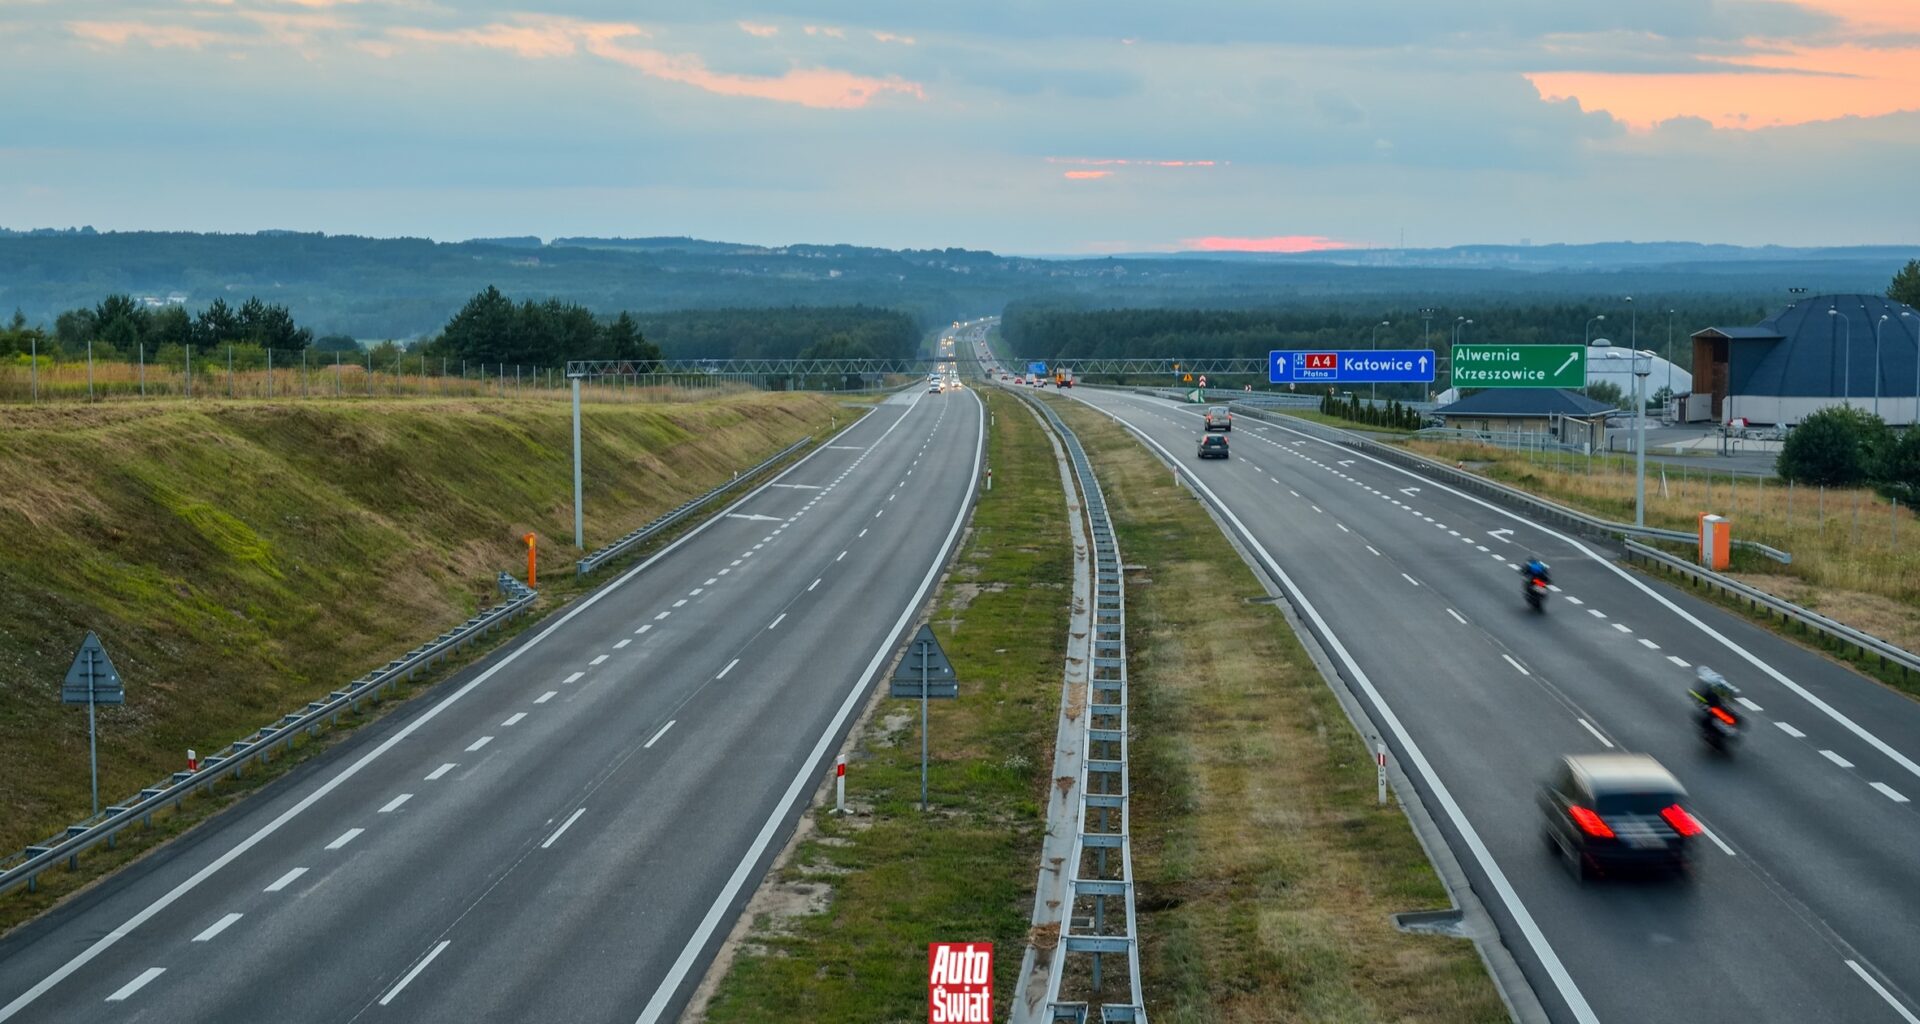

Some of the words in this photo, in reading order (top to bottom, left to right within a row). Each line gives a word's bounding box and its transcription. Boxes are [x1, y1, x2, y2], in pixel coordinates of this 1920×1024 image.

[1456, 348, 1520, 361] Alwernia
[1344, 358, 1413, 371] Katowice
[1455, 367, 1545, 380] Krzeszowice
